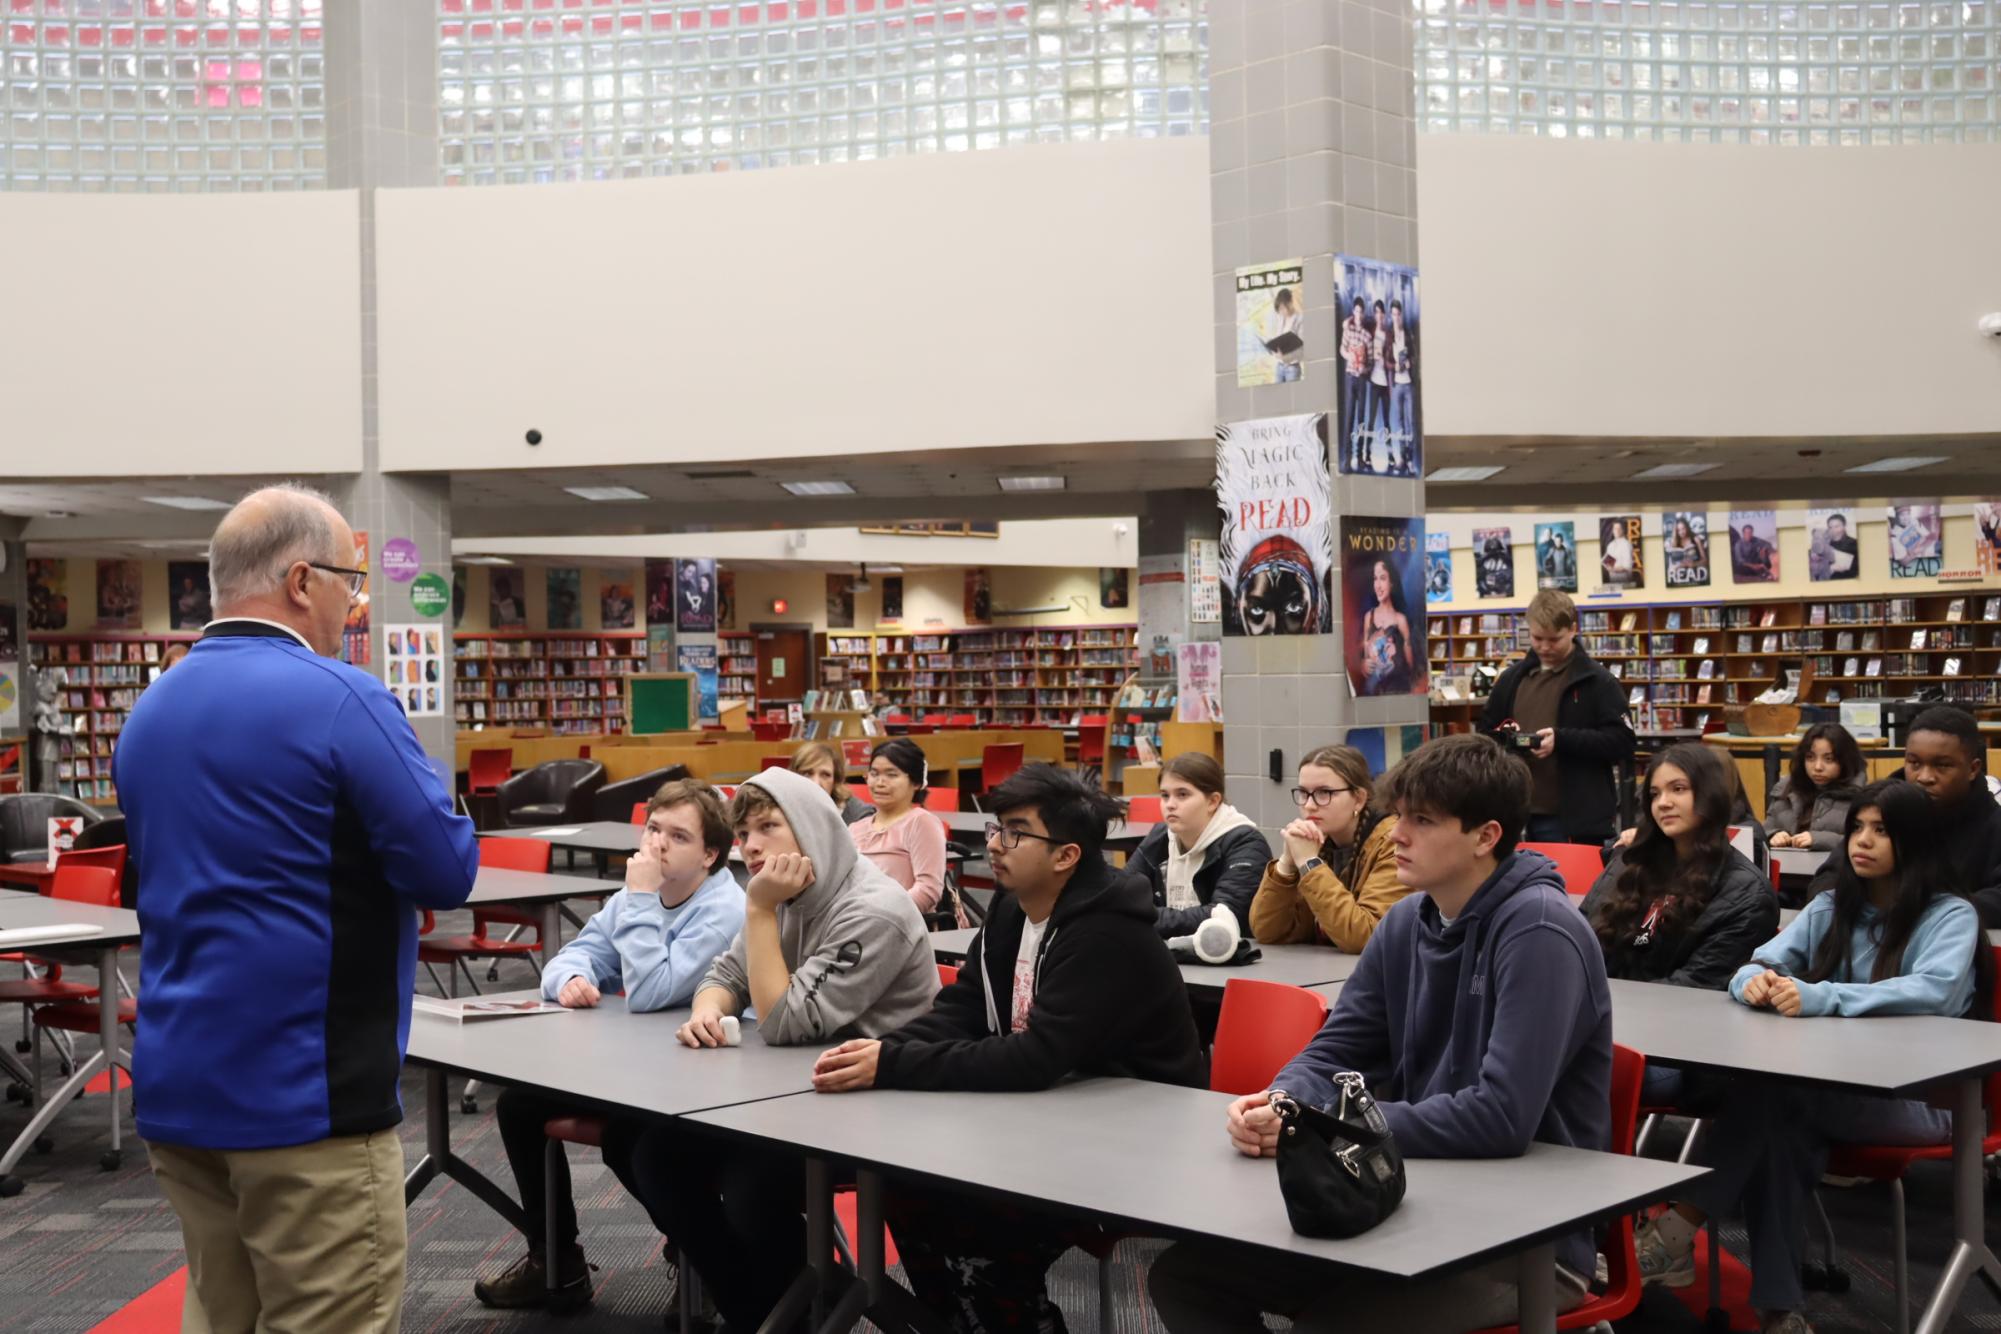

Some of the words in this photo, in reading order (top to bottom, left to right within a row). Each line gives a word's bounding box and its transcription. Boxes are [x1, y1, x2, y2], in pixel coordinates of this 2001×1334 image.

[1239, 277, 1249, 289] My
[1266, 272, 1277, 285] My
[1251, 427, 1291, 441] BRING
[1240, 444, 1303, 469] MAGIC
[1251, 472, 1296, 490] BACK
[1240, 496, 1311, 532] READ
[1349, 534, 1417, 552] WONDER
[1667, 567, 1707, 584] READ
[1890, 557, 1940, 578] READ
[1938, 570, 1982, 578] HORROR
